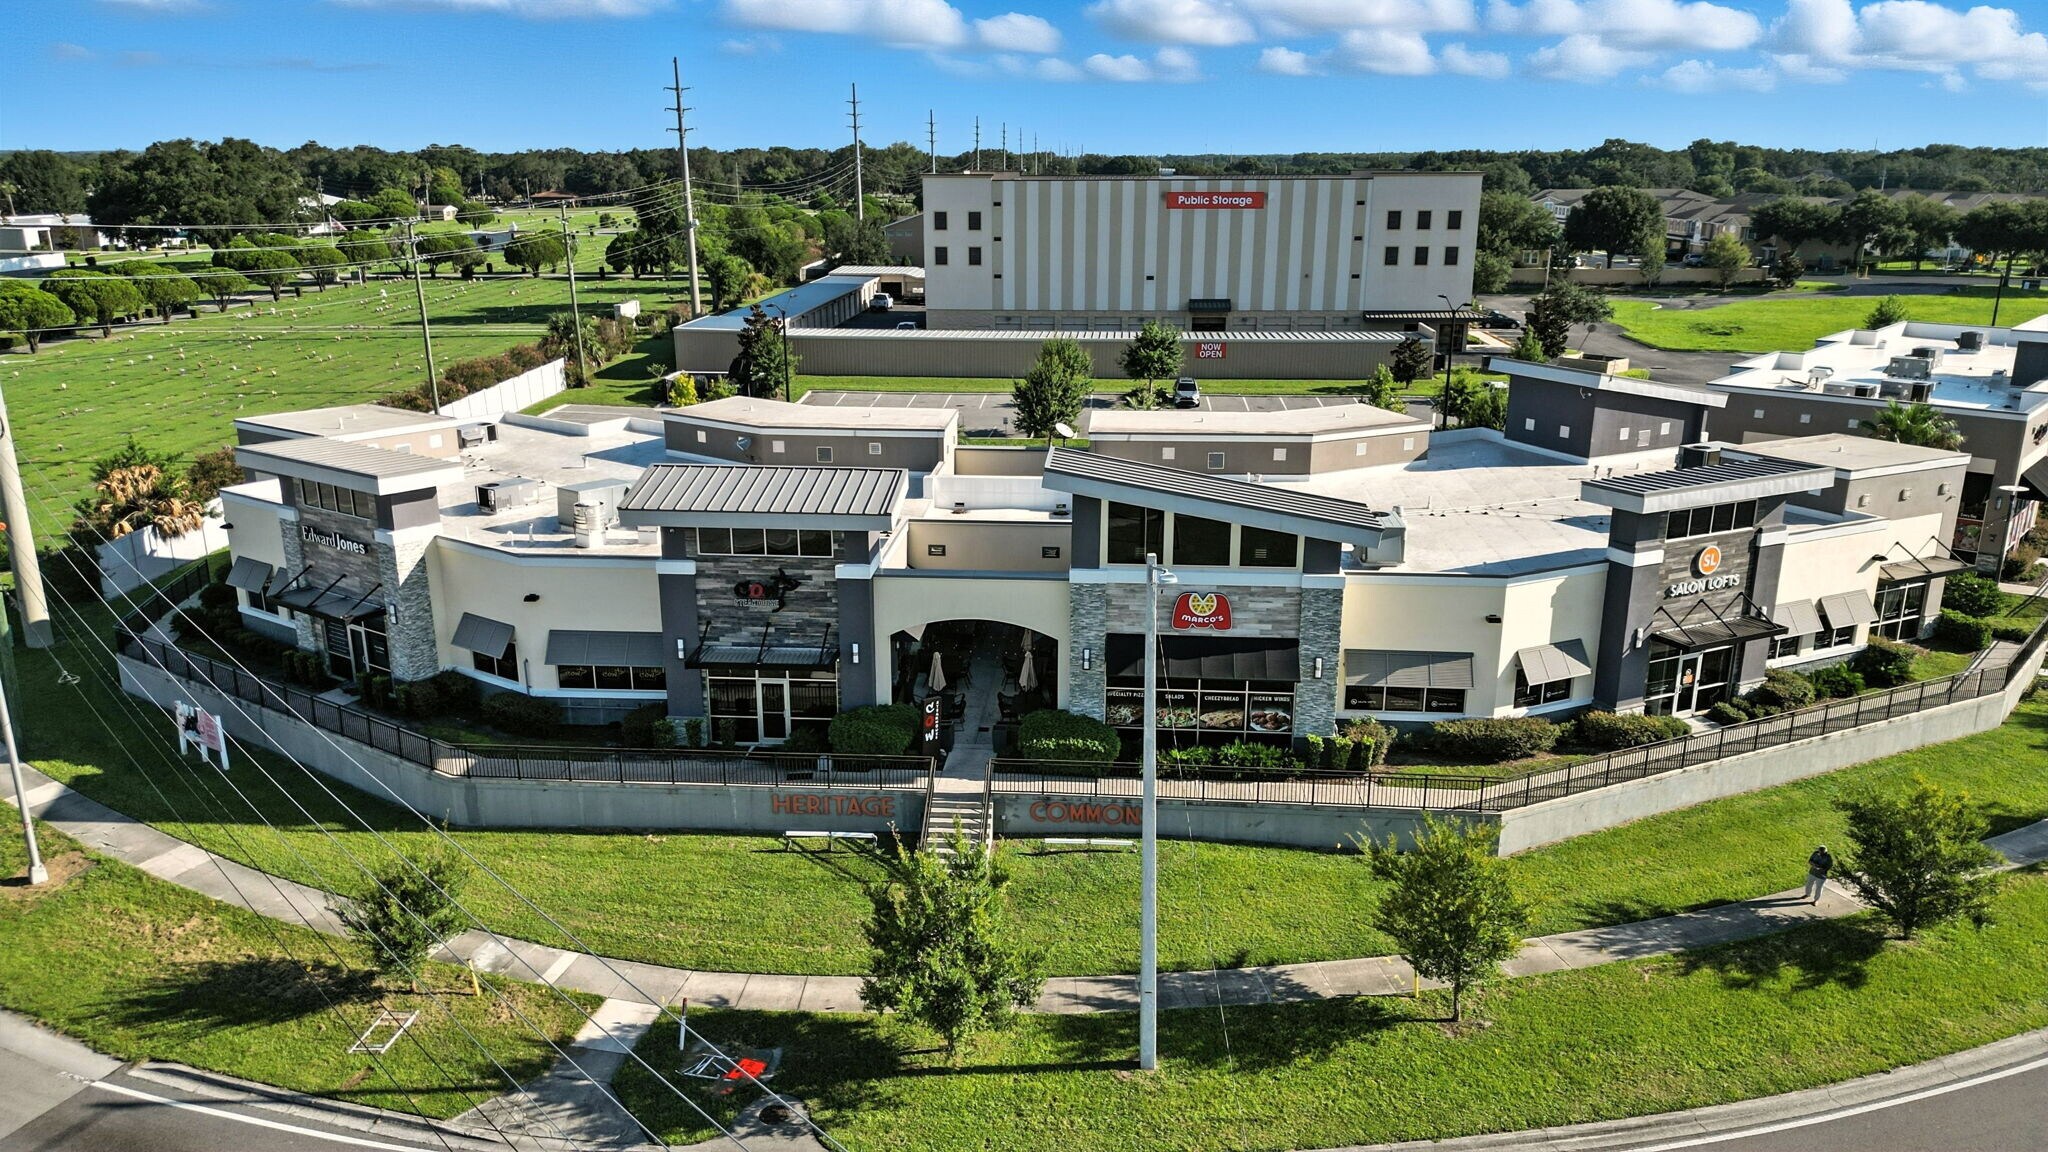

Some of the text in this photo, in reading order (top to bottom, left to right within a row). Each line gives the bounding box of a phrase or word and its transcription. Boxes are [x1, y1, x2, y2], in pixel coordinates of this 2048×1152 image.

[1178, 195, 1253, 207] Public Storage
[1201, 343, 1221, 351] NOW
[1199, 350, 1222, 358] OPEN
[302, 525, 365, 555] Edward Jones
[1703, 553, 1717, 567] SL
[1670, 573, 1740, 597] SALON LOFTS
[1181, 614, 1224, 623] MARCO'S
[771, 793, 896, 817] HERITAGE
